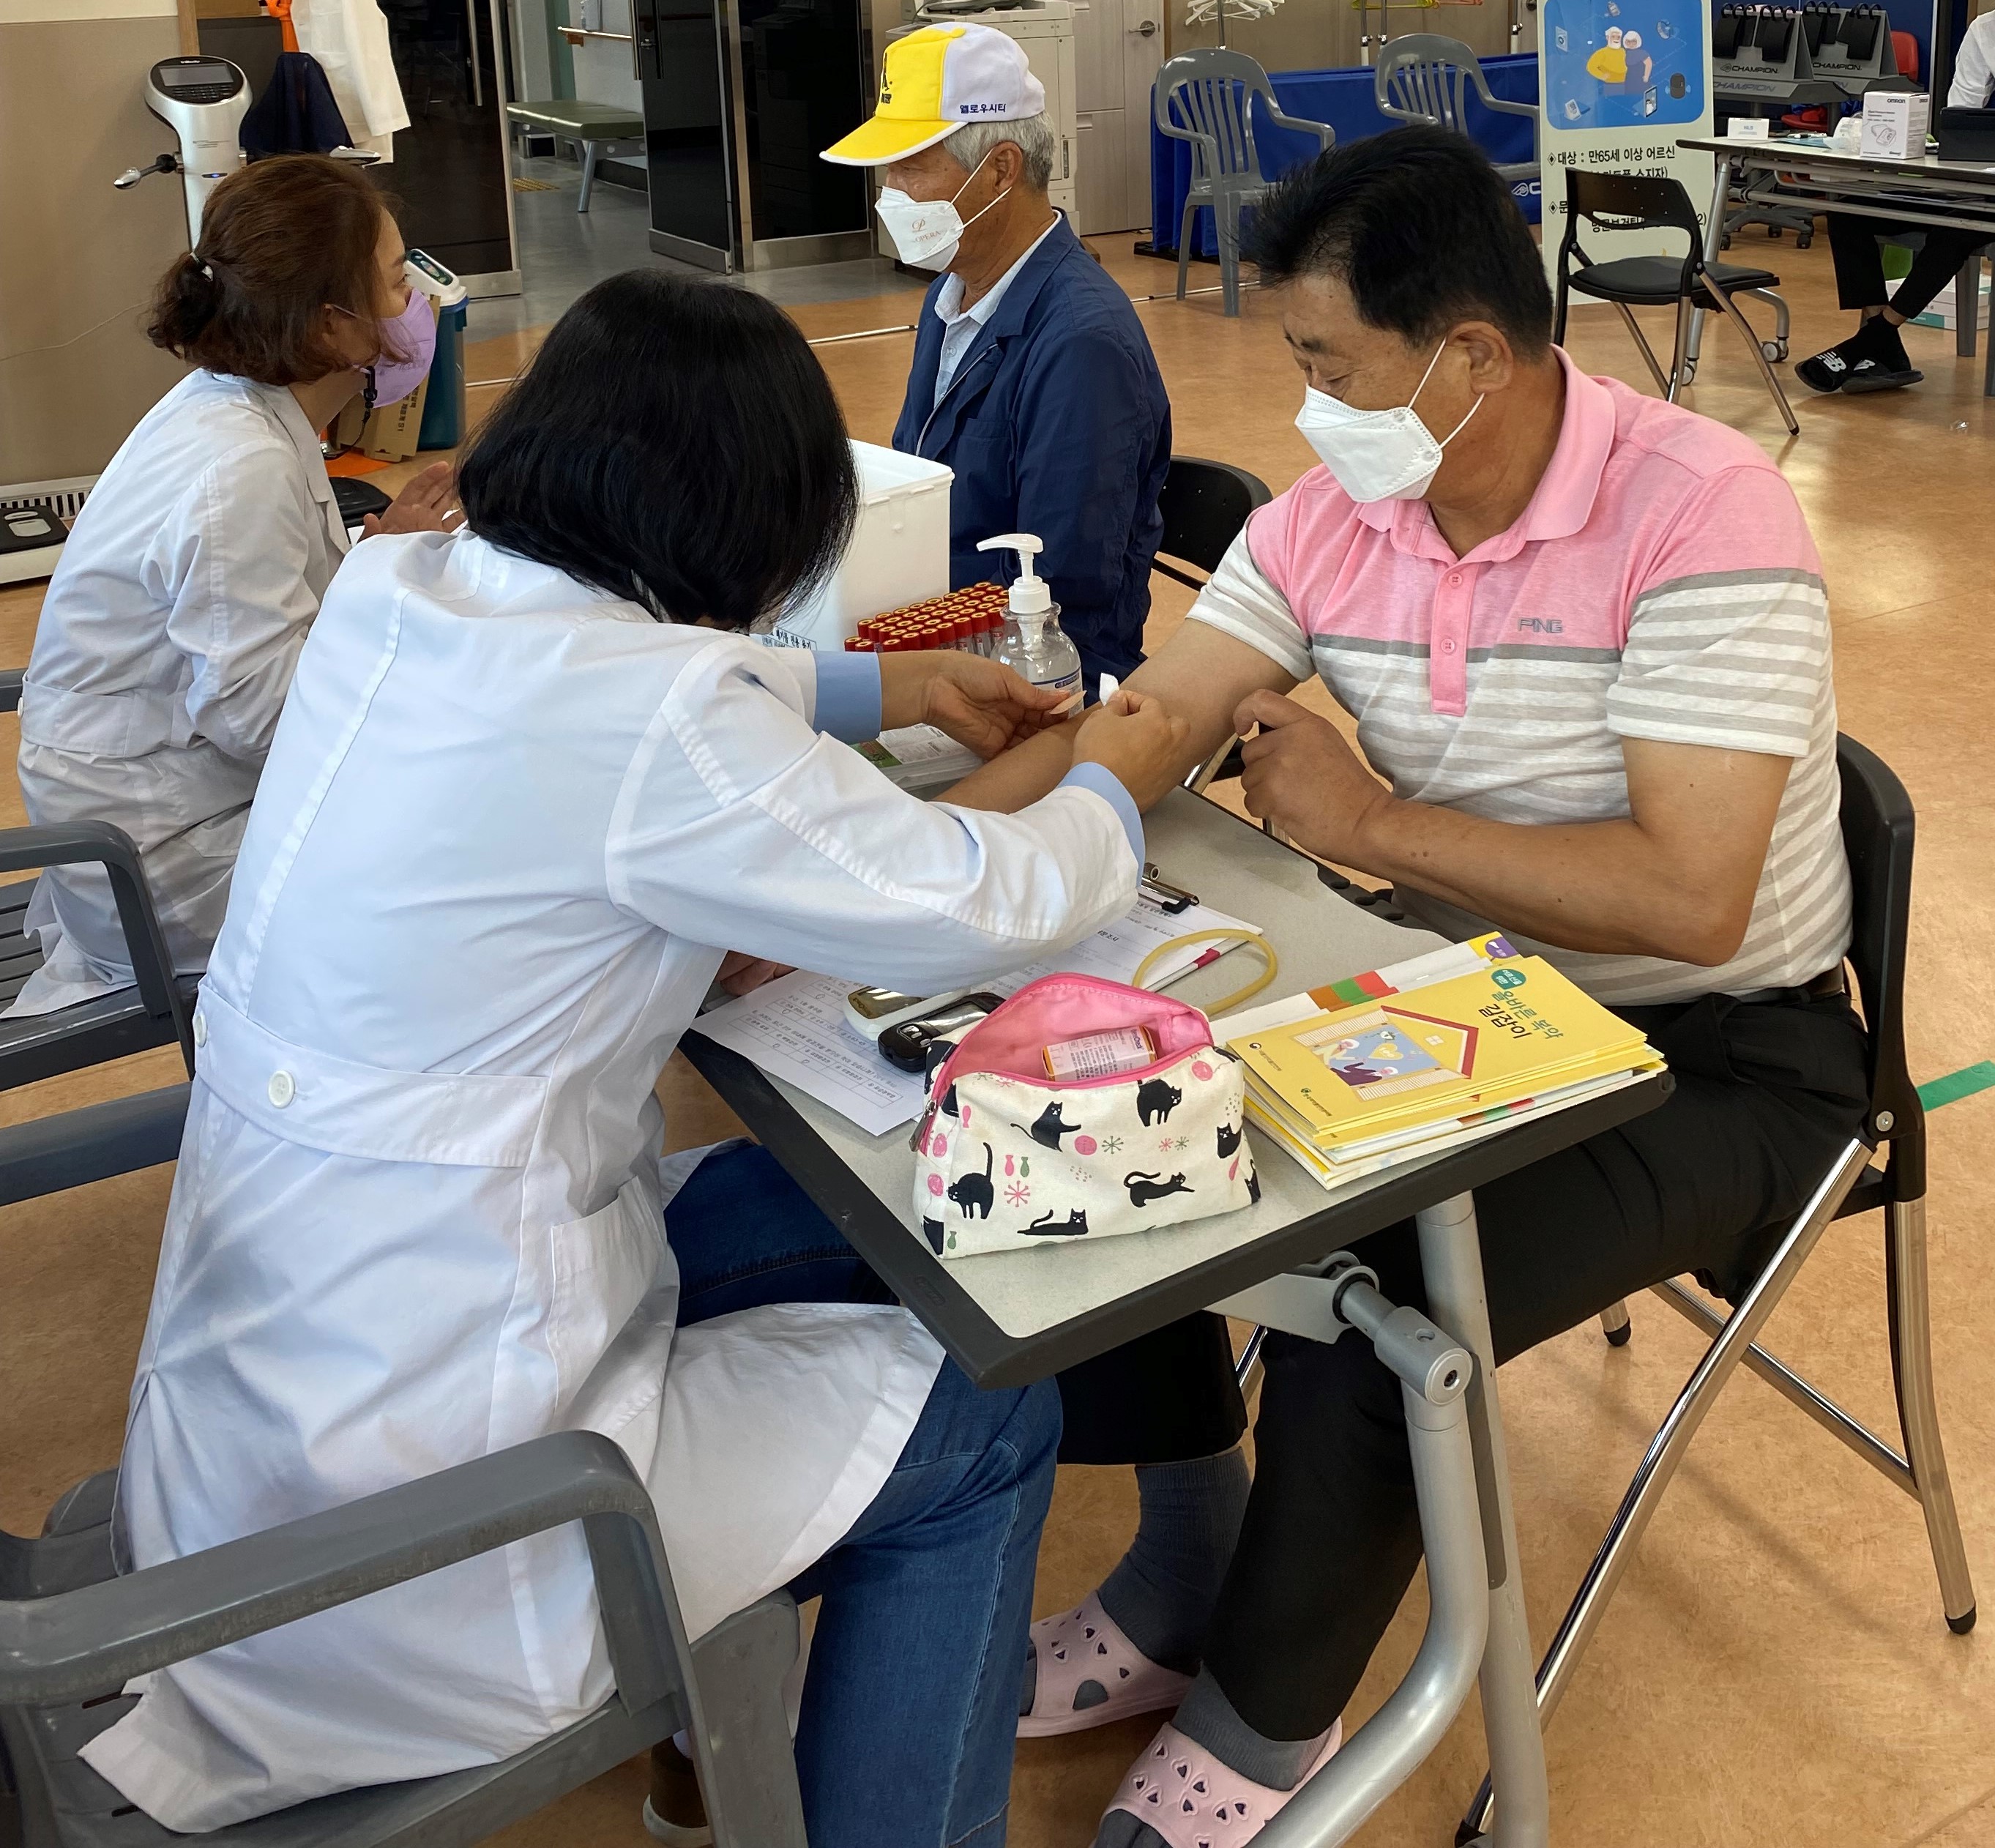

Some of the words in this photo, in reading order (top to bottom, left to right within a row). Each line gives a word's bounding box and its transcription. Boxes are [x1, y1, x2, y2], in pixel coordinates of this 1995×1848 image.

[1732, 65, 1777, 73] CHAMPION
[1813, 62, 1860, 70] CHAMPION
[1558, 152, 1577, 165] 대상
[1589, 149, 1620, 163] 만65세
[1624, 149, 1643, 161] 이상
[1647, 146, 1676, 159] 어르신
[1491, 991, 1537, 1020] 올바른
[1478, 1004, 1532, 1039] 길잡이
